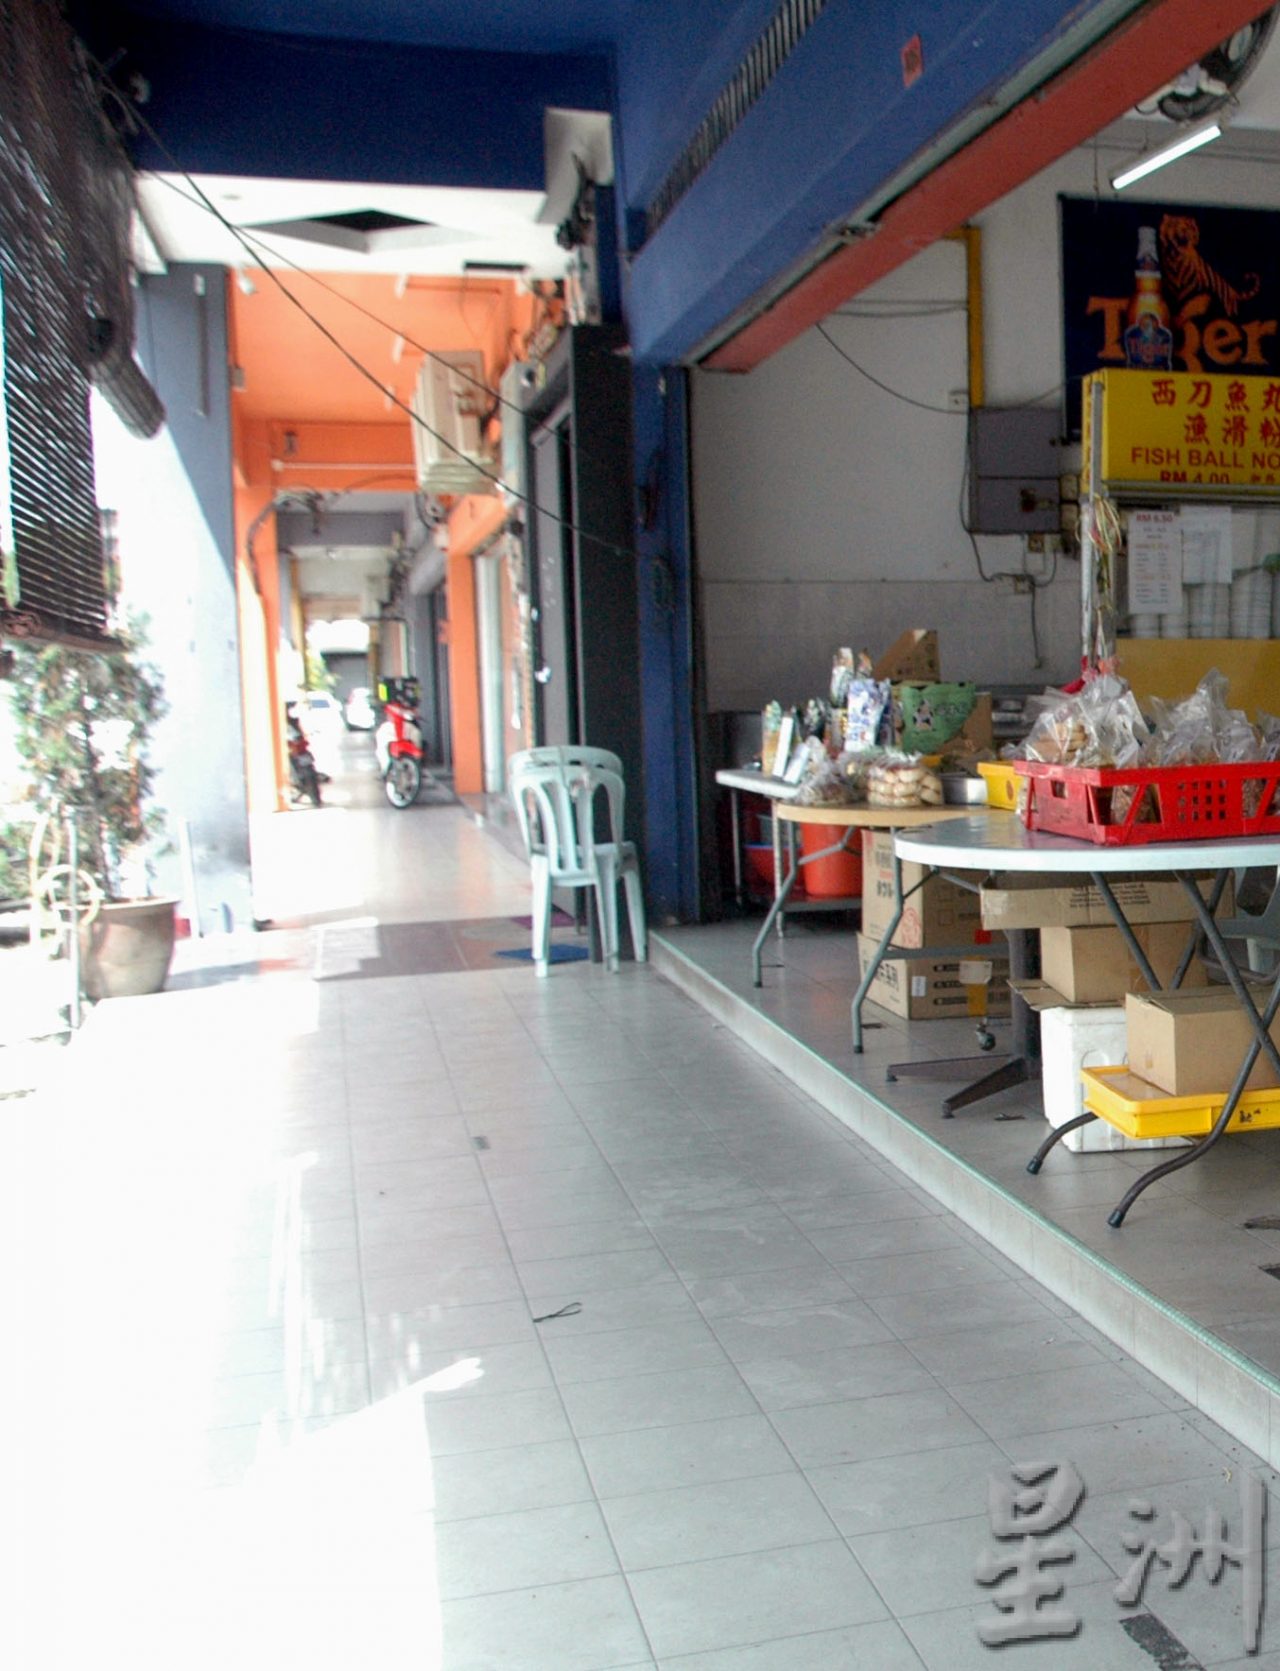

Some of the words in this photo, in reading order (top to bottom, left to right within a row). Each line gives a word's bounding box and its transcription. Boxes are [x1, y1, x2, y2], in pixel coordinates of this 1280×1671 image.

[1086, 293, 1279, 373] Tger
[1131, 447, 1180, 466] FISH
[1188, 451, 1244, 469] BALL
[1160, 470, 1187, 484] RM
[1193, 472, 1230, 485] 400
